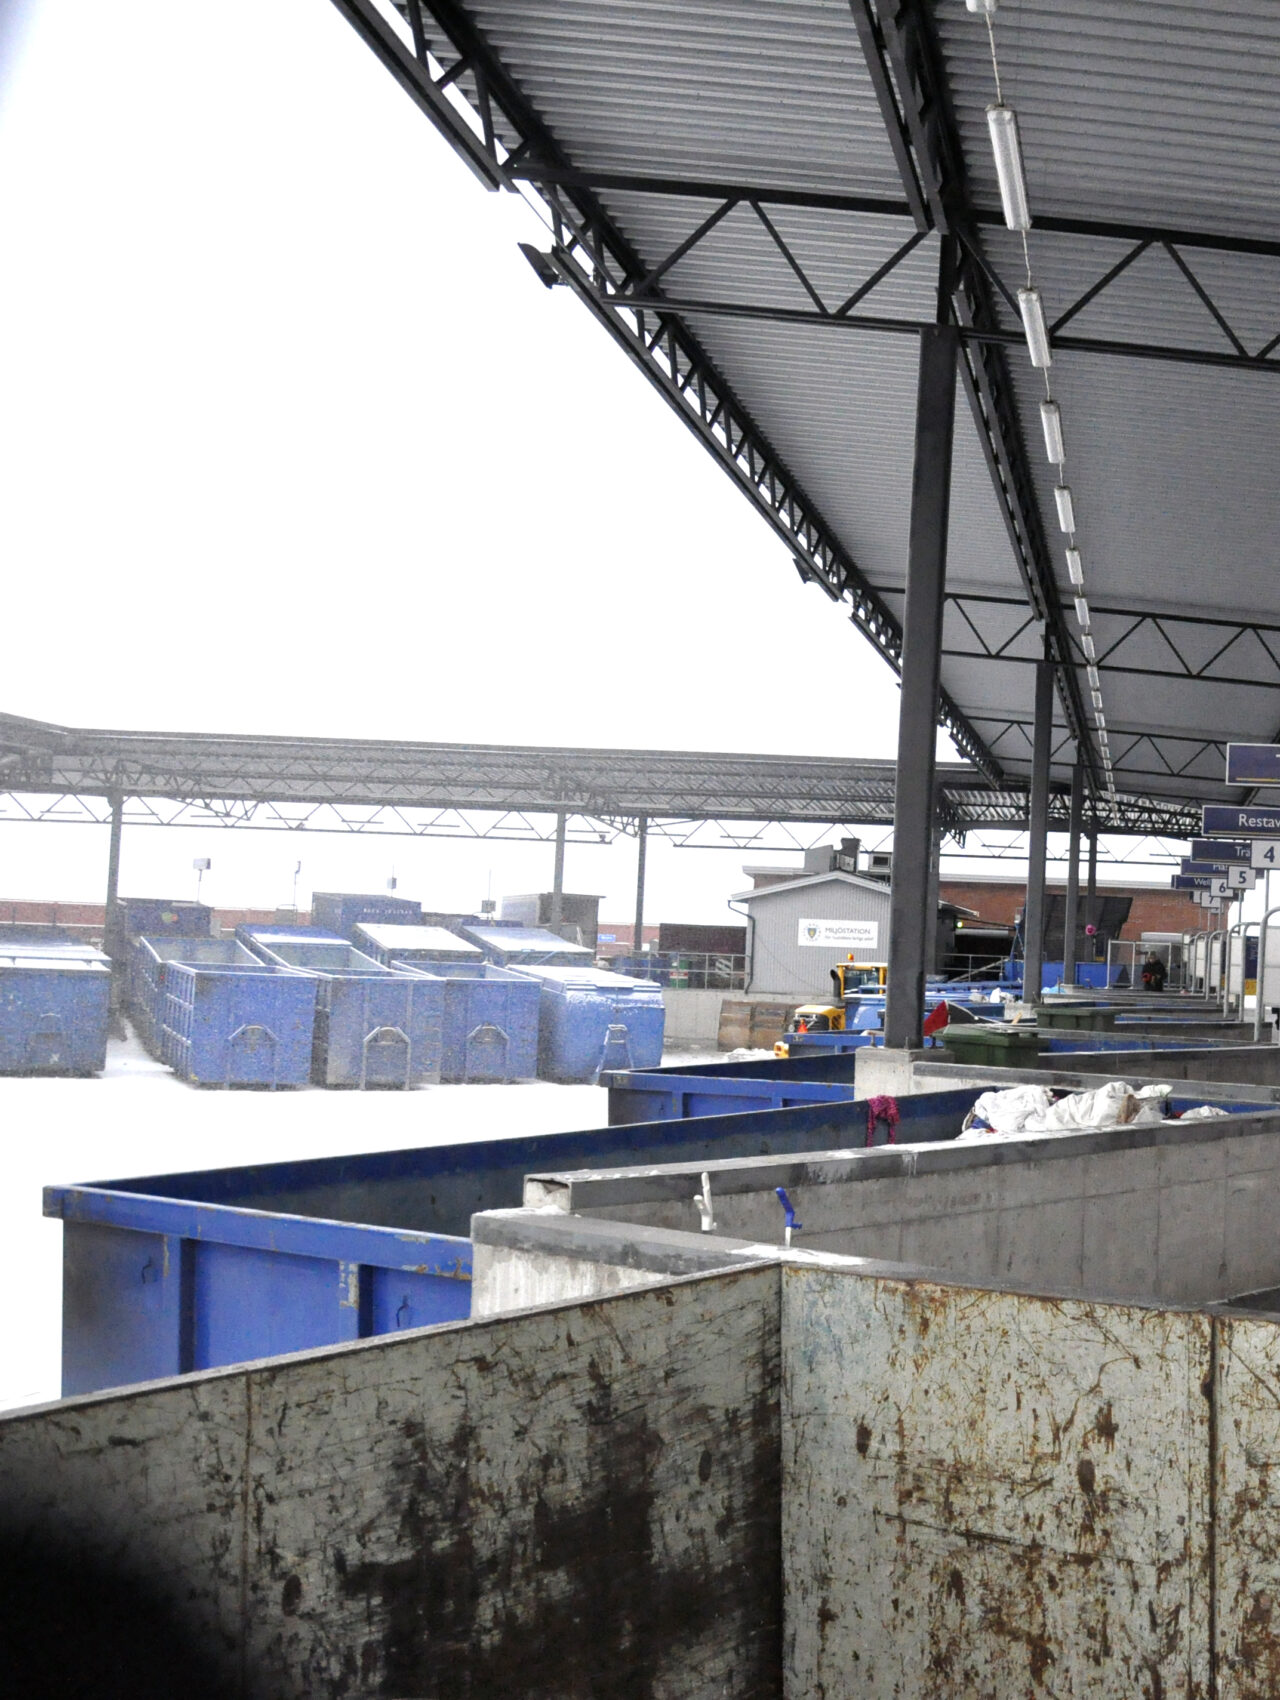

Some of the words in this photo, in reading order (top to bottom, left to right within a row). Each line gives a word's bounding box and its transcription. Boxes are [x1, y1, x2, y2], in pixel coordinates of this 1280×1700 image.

[1263, 846, 1275, 863] 4
[1238, 871, 1247, 884] 5
[1218, 882, 1226, 893] 6
